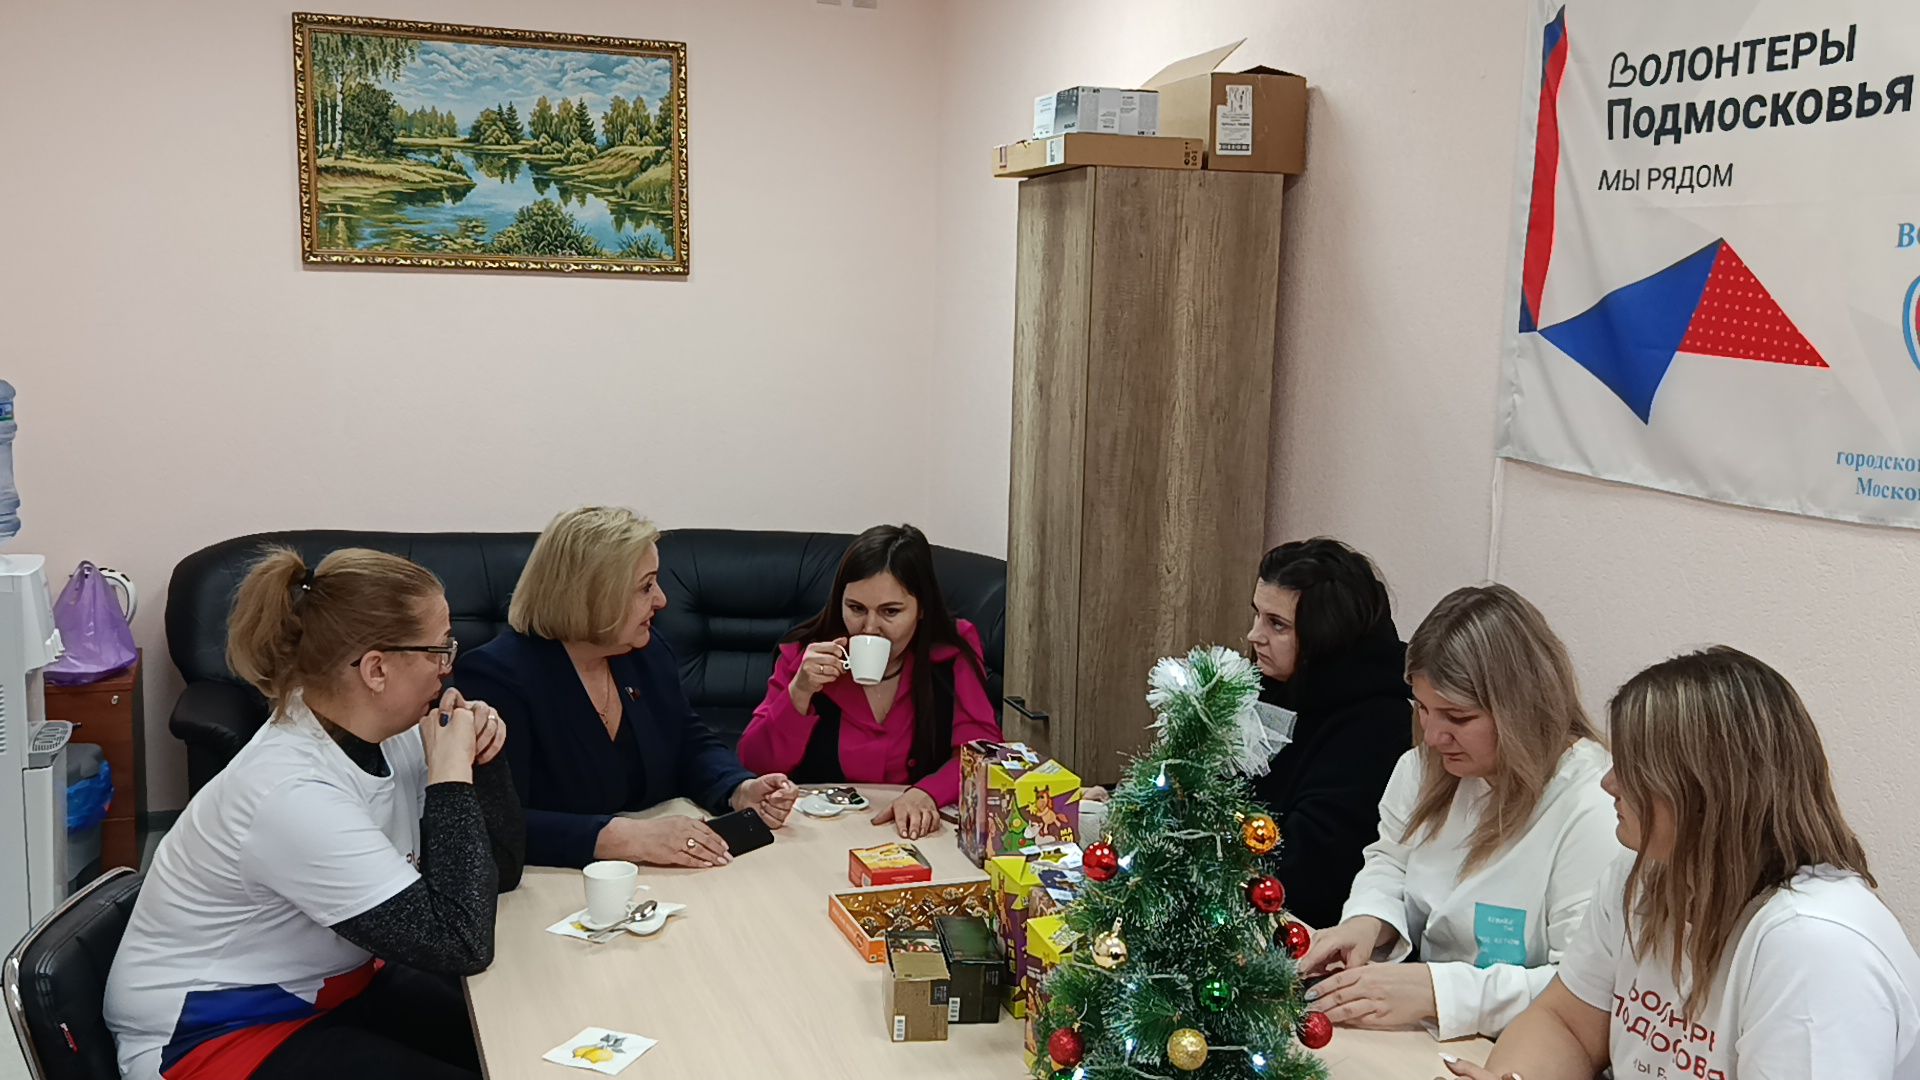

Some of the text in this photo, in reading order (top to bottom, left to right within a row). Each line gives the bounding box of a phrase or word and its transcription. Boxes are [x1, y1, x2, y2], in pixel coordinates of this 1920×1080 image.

[1598, 163, 1733, 194] МЫ РЯДОМ
[1836, 451, 1920, 472] городско
[1856, 477, 1920, 501] Моско
